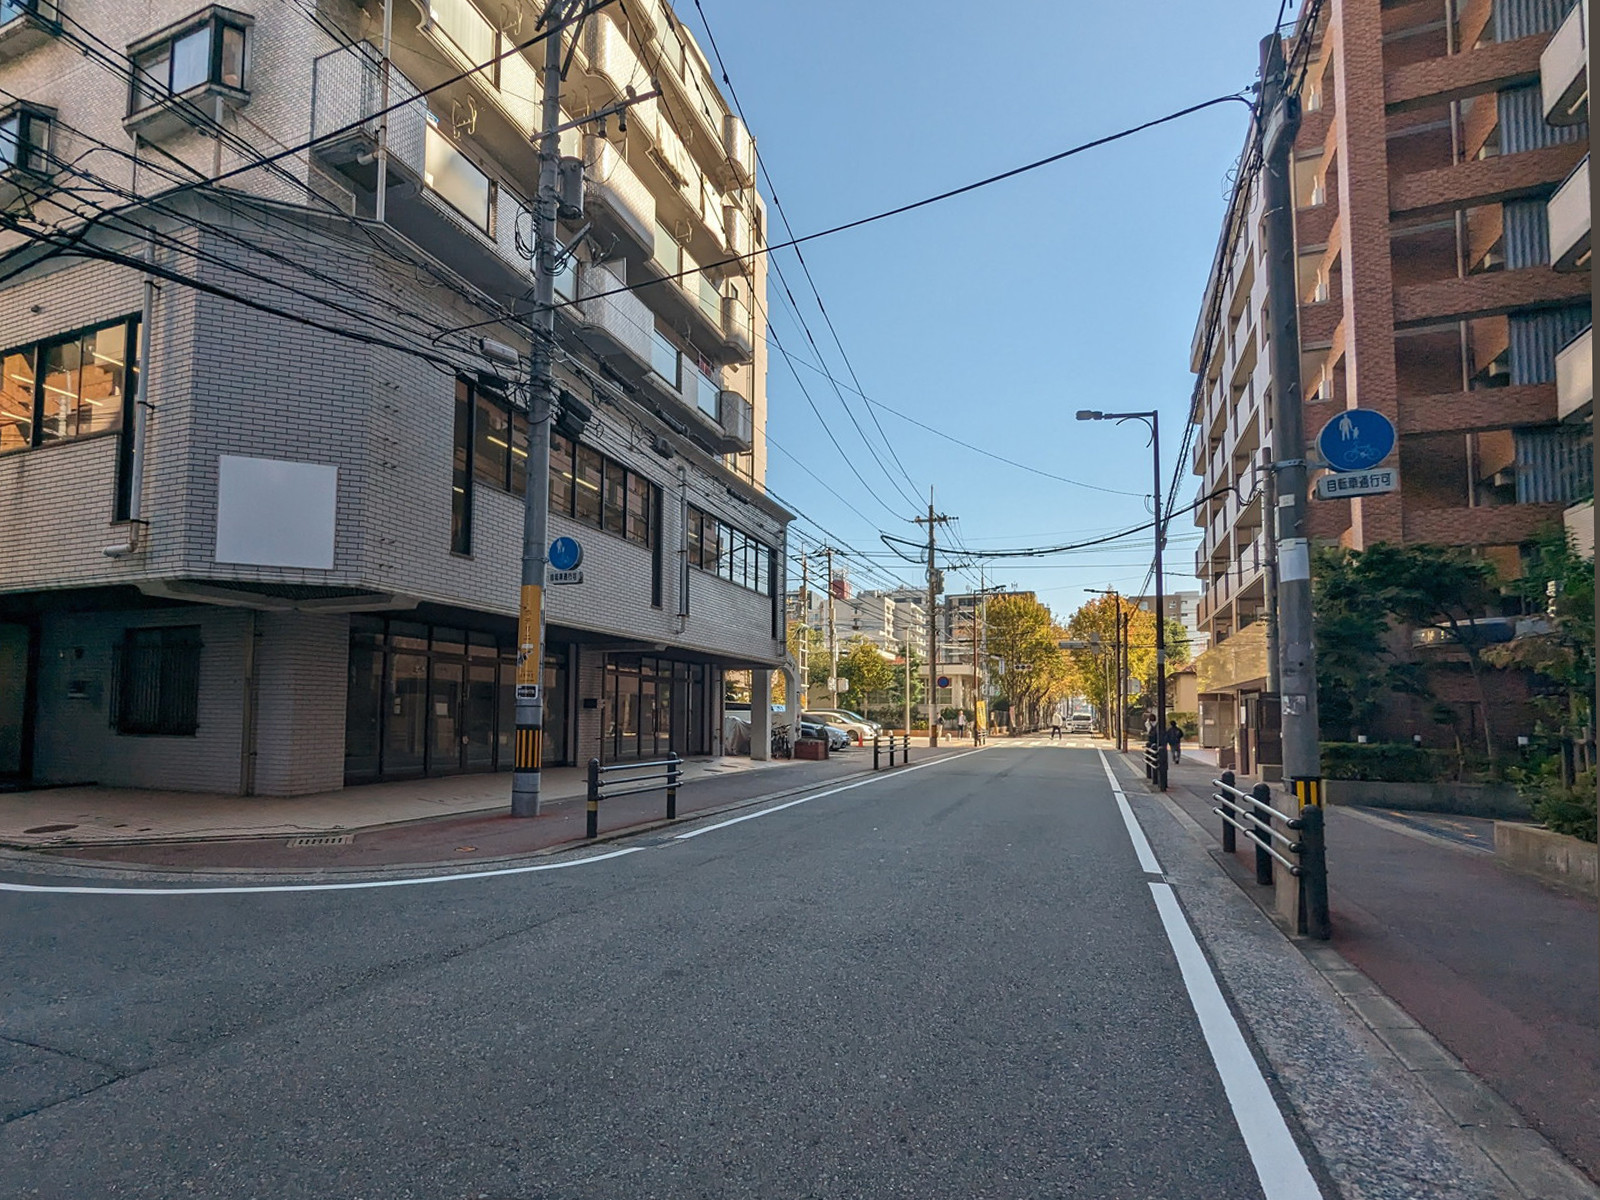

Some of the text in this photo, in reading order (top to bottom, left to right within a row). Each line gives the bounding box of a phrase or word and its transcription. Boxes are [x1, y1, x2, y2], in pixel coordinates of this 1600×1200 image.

[1327, 473, 1391, 492] 自転車通行可
